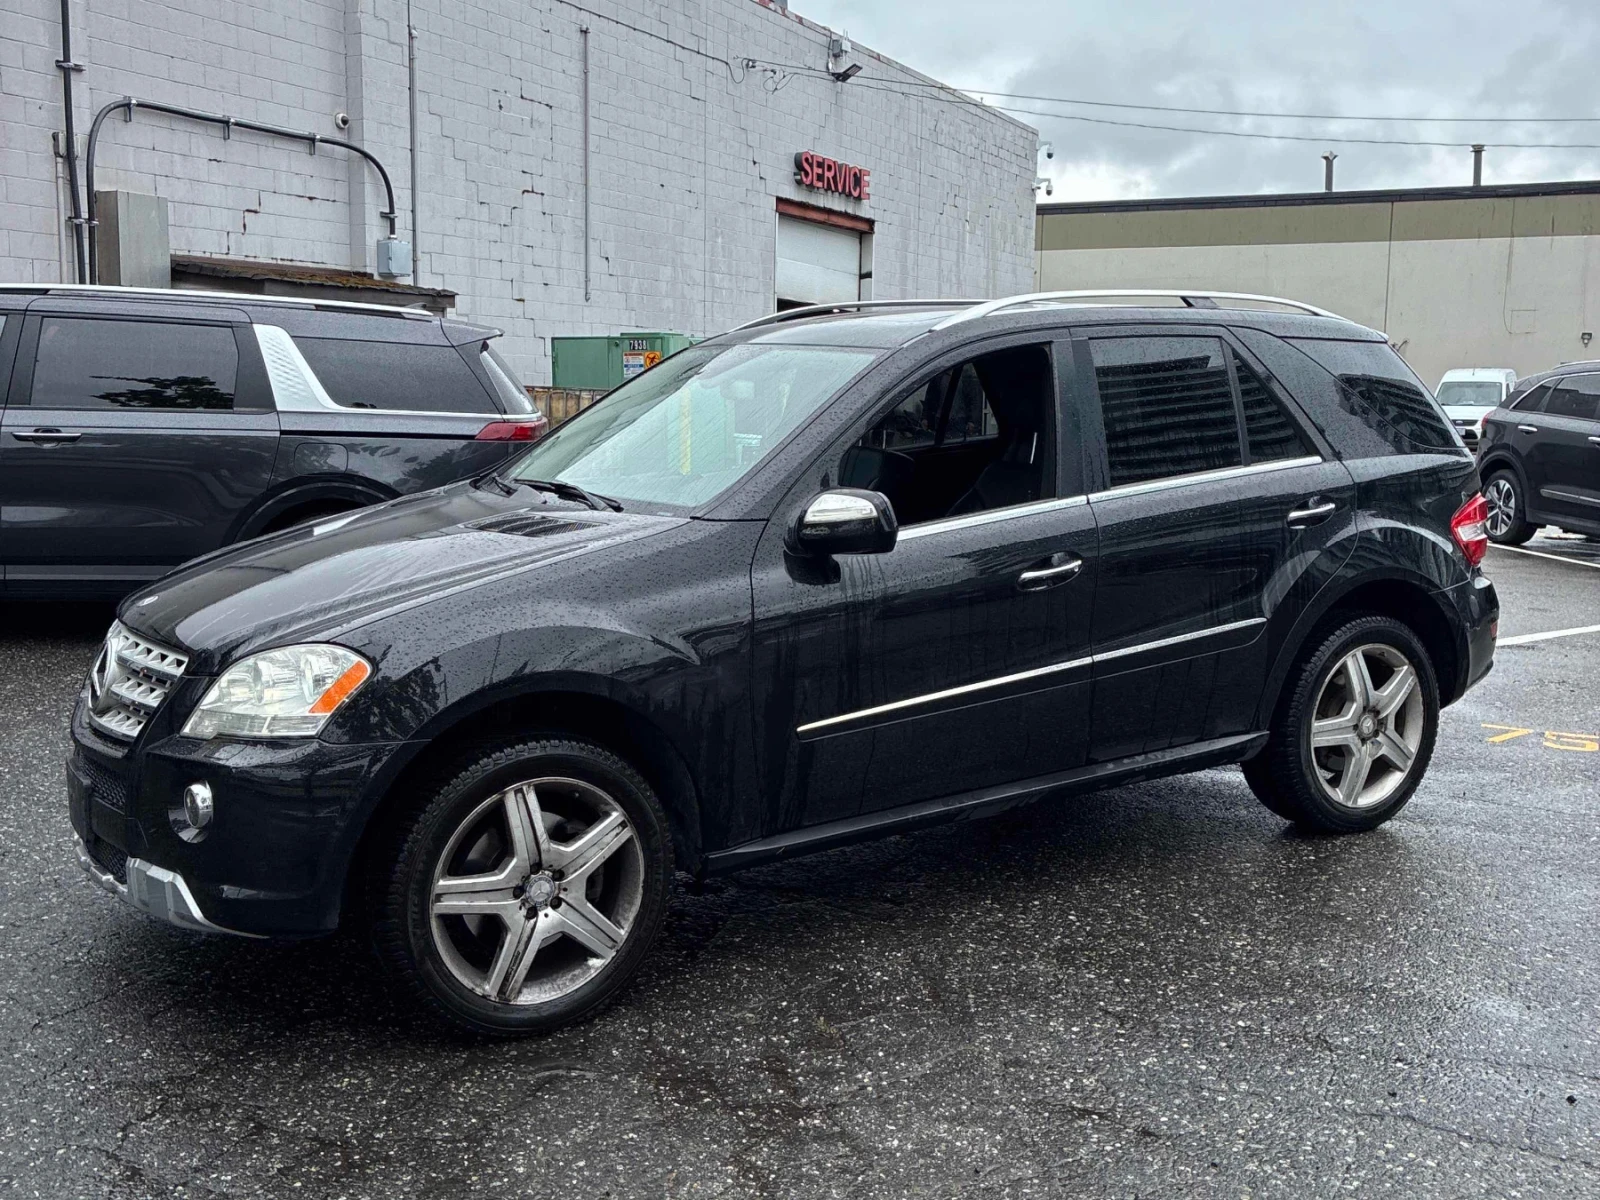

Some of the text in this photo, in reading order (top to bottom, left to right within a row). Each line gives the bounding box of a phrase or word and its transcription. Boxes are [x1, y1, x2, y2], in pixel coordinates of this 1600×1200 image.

[799, 150, 870, 200] SERVICE
[629, 339, 647, 350] 7938
[1480, 723, 1600, 752] 75
